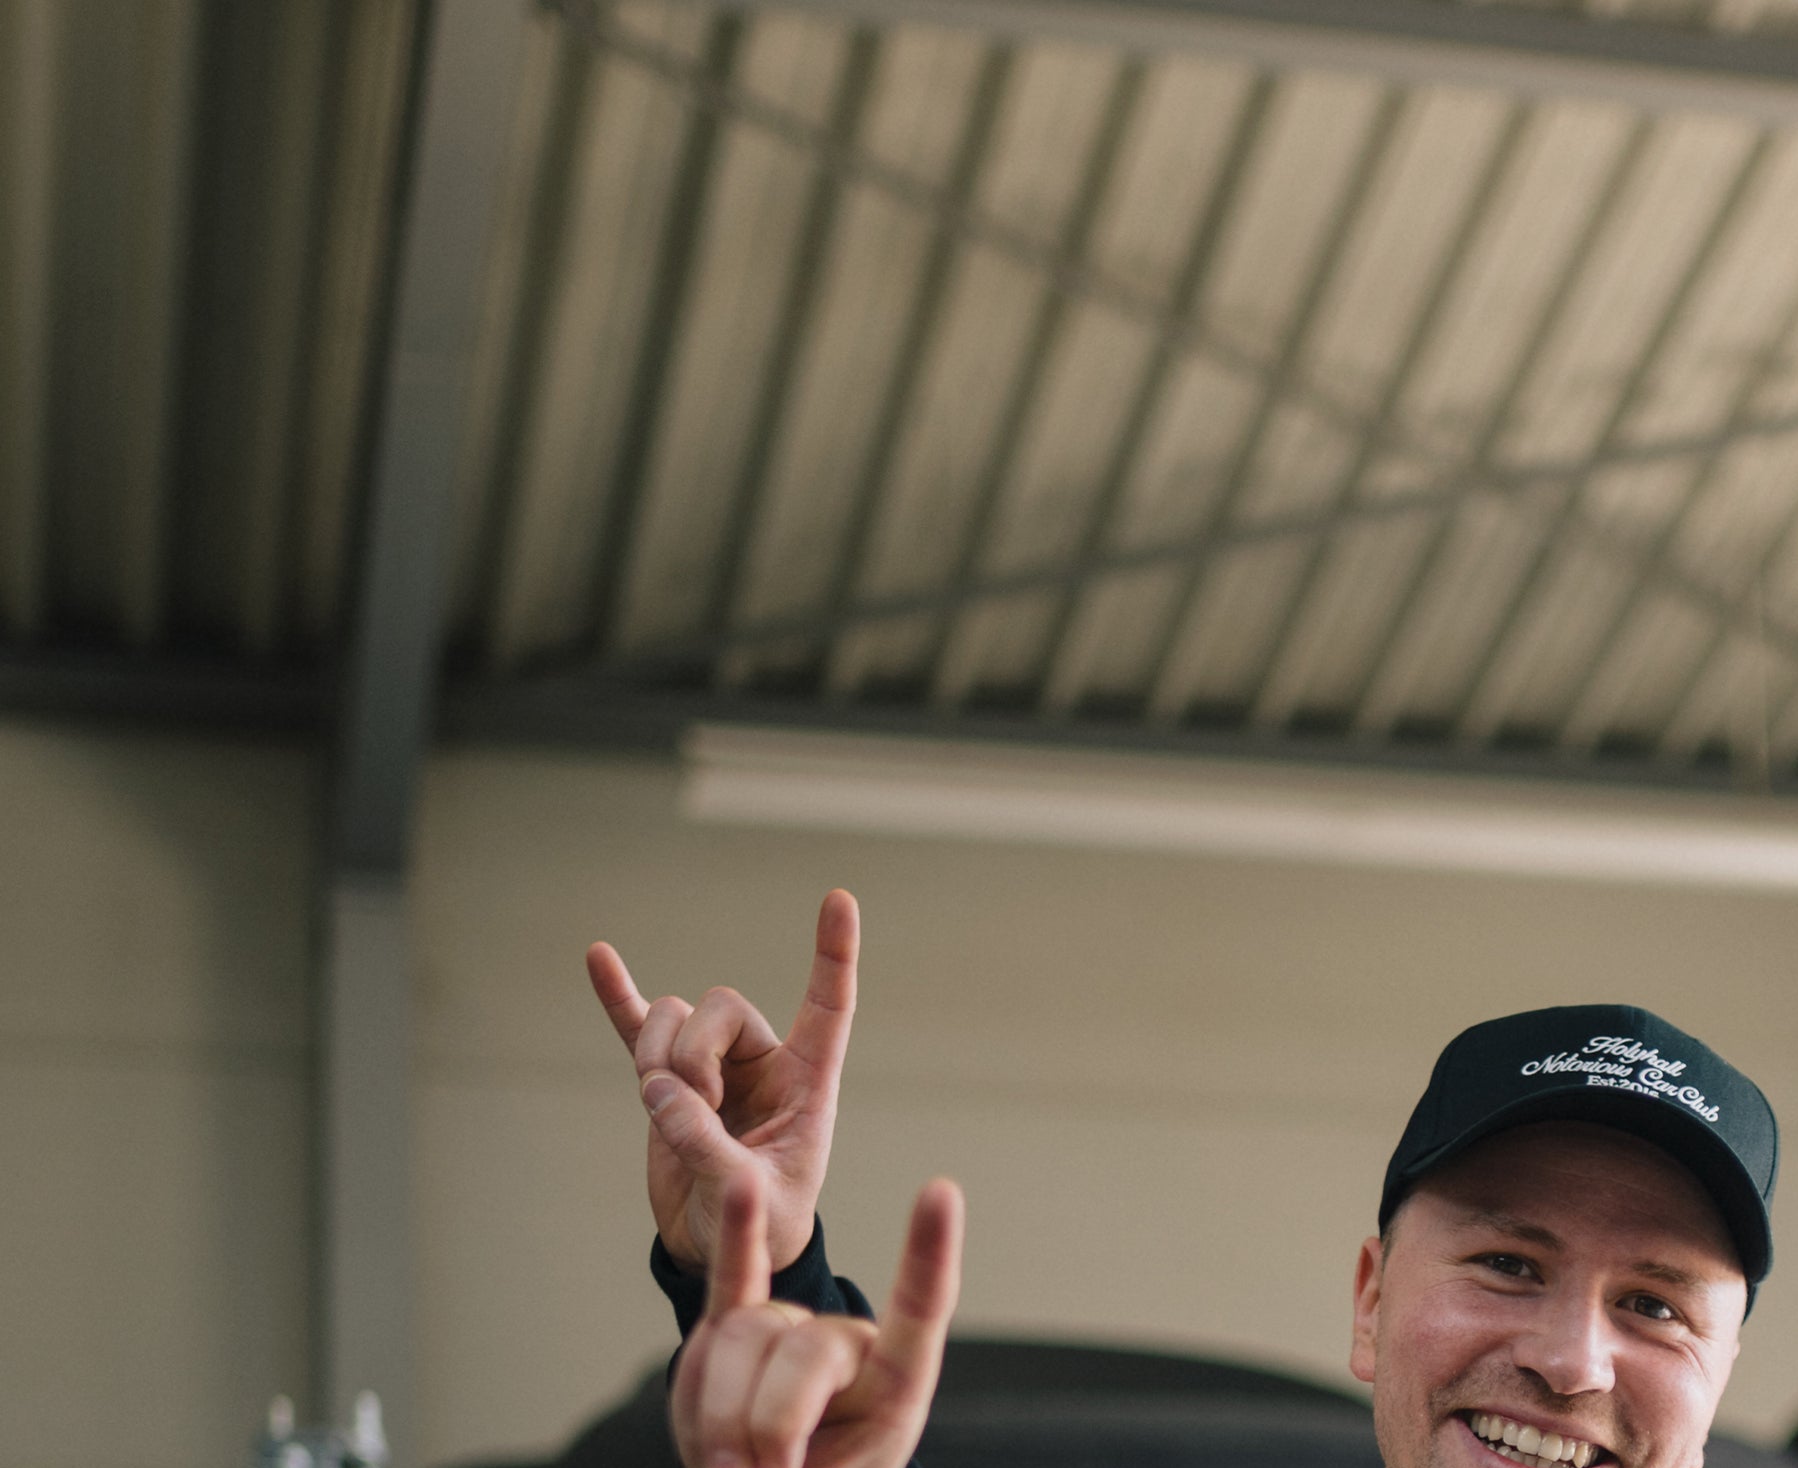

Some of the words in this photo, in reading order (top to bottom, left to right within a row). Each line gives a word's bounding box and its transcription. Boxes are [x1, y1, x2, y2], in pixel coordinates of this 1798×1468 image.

[1582, 1036, 1687, 1077] Holyhall
[1521, 1052, 1633, 1077] Notorious
[1638, 1067, 1681, 1096] Car
[1677, 1086, 1719, 1122] Club
